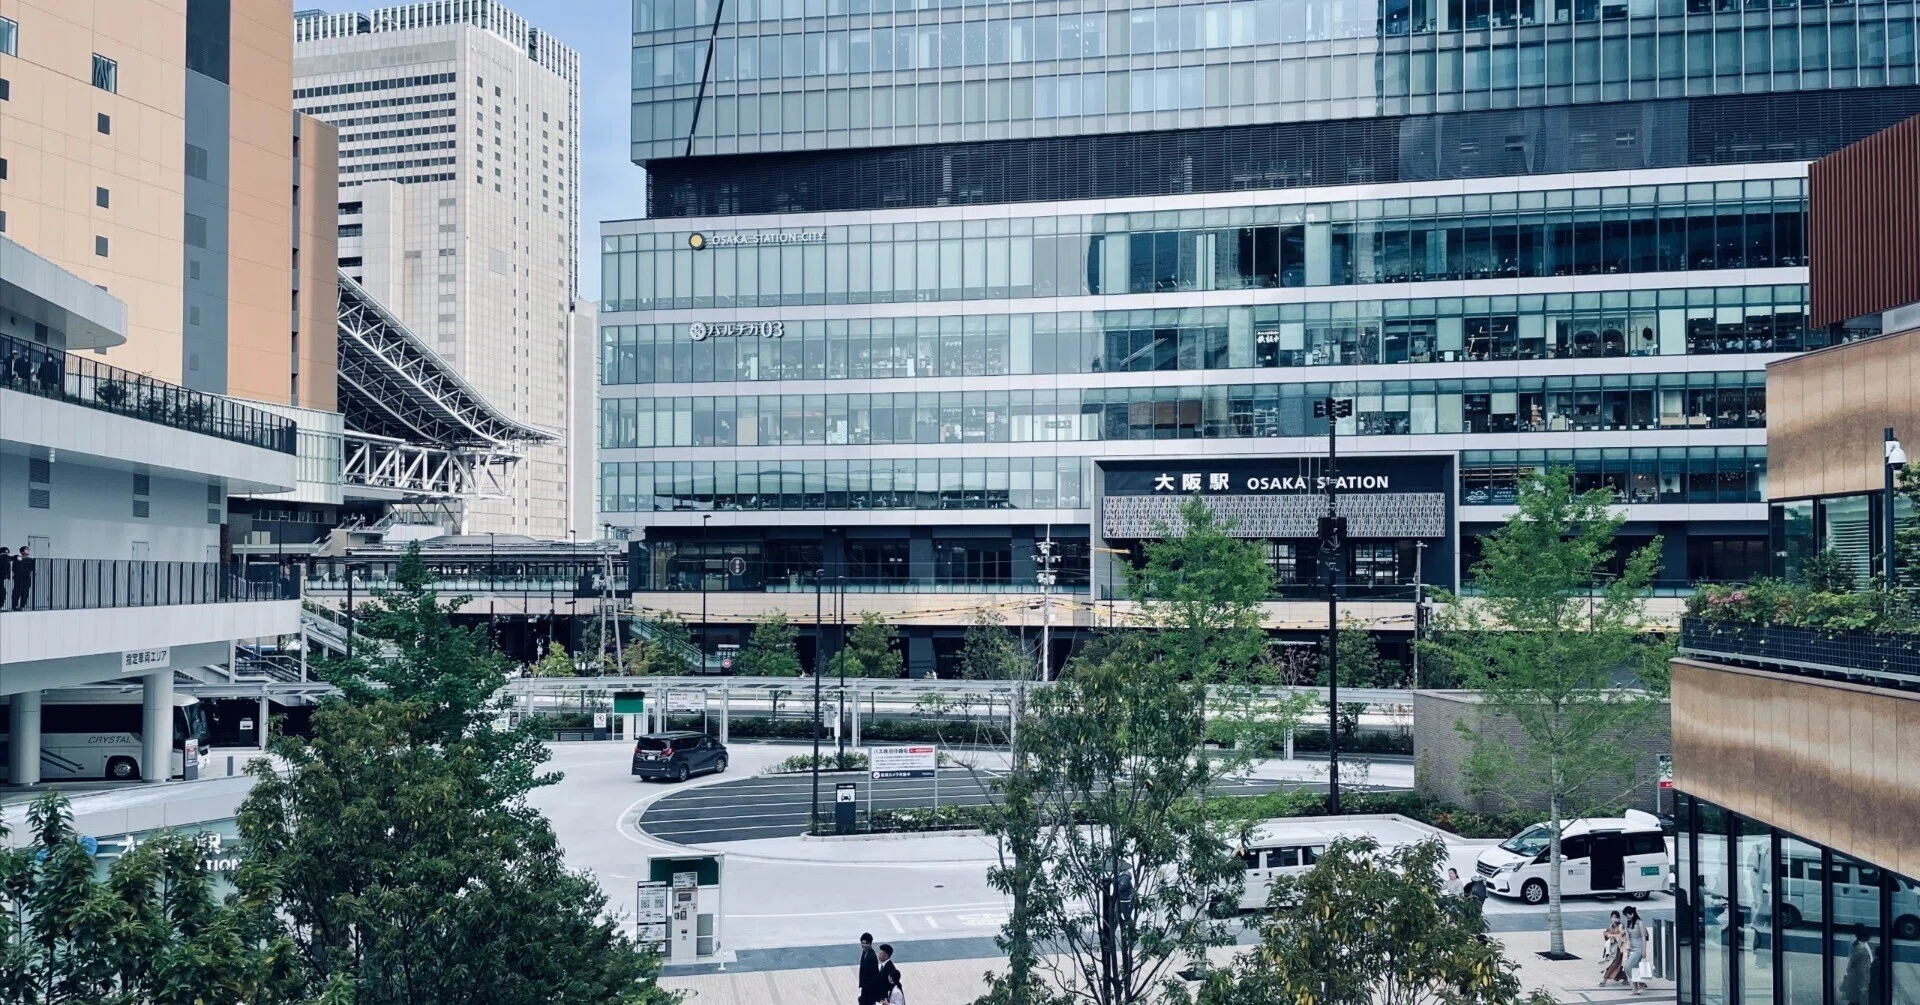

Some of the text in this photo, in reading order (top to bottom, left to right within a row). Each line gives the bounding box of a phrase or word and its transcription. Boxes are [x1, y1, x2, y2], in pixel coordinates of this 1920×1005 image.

[712, 231, 826, 245] OSAKA STATION CITY
[1154, 473, 1229, 491] 大阪駅
[1247, 476, 1307, 490] OSAKA
[88, 735, 131, 744] CRYSTAL
